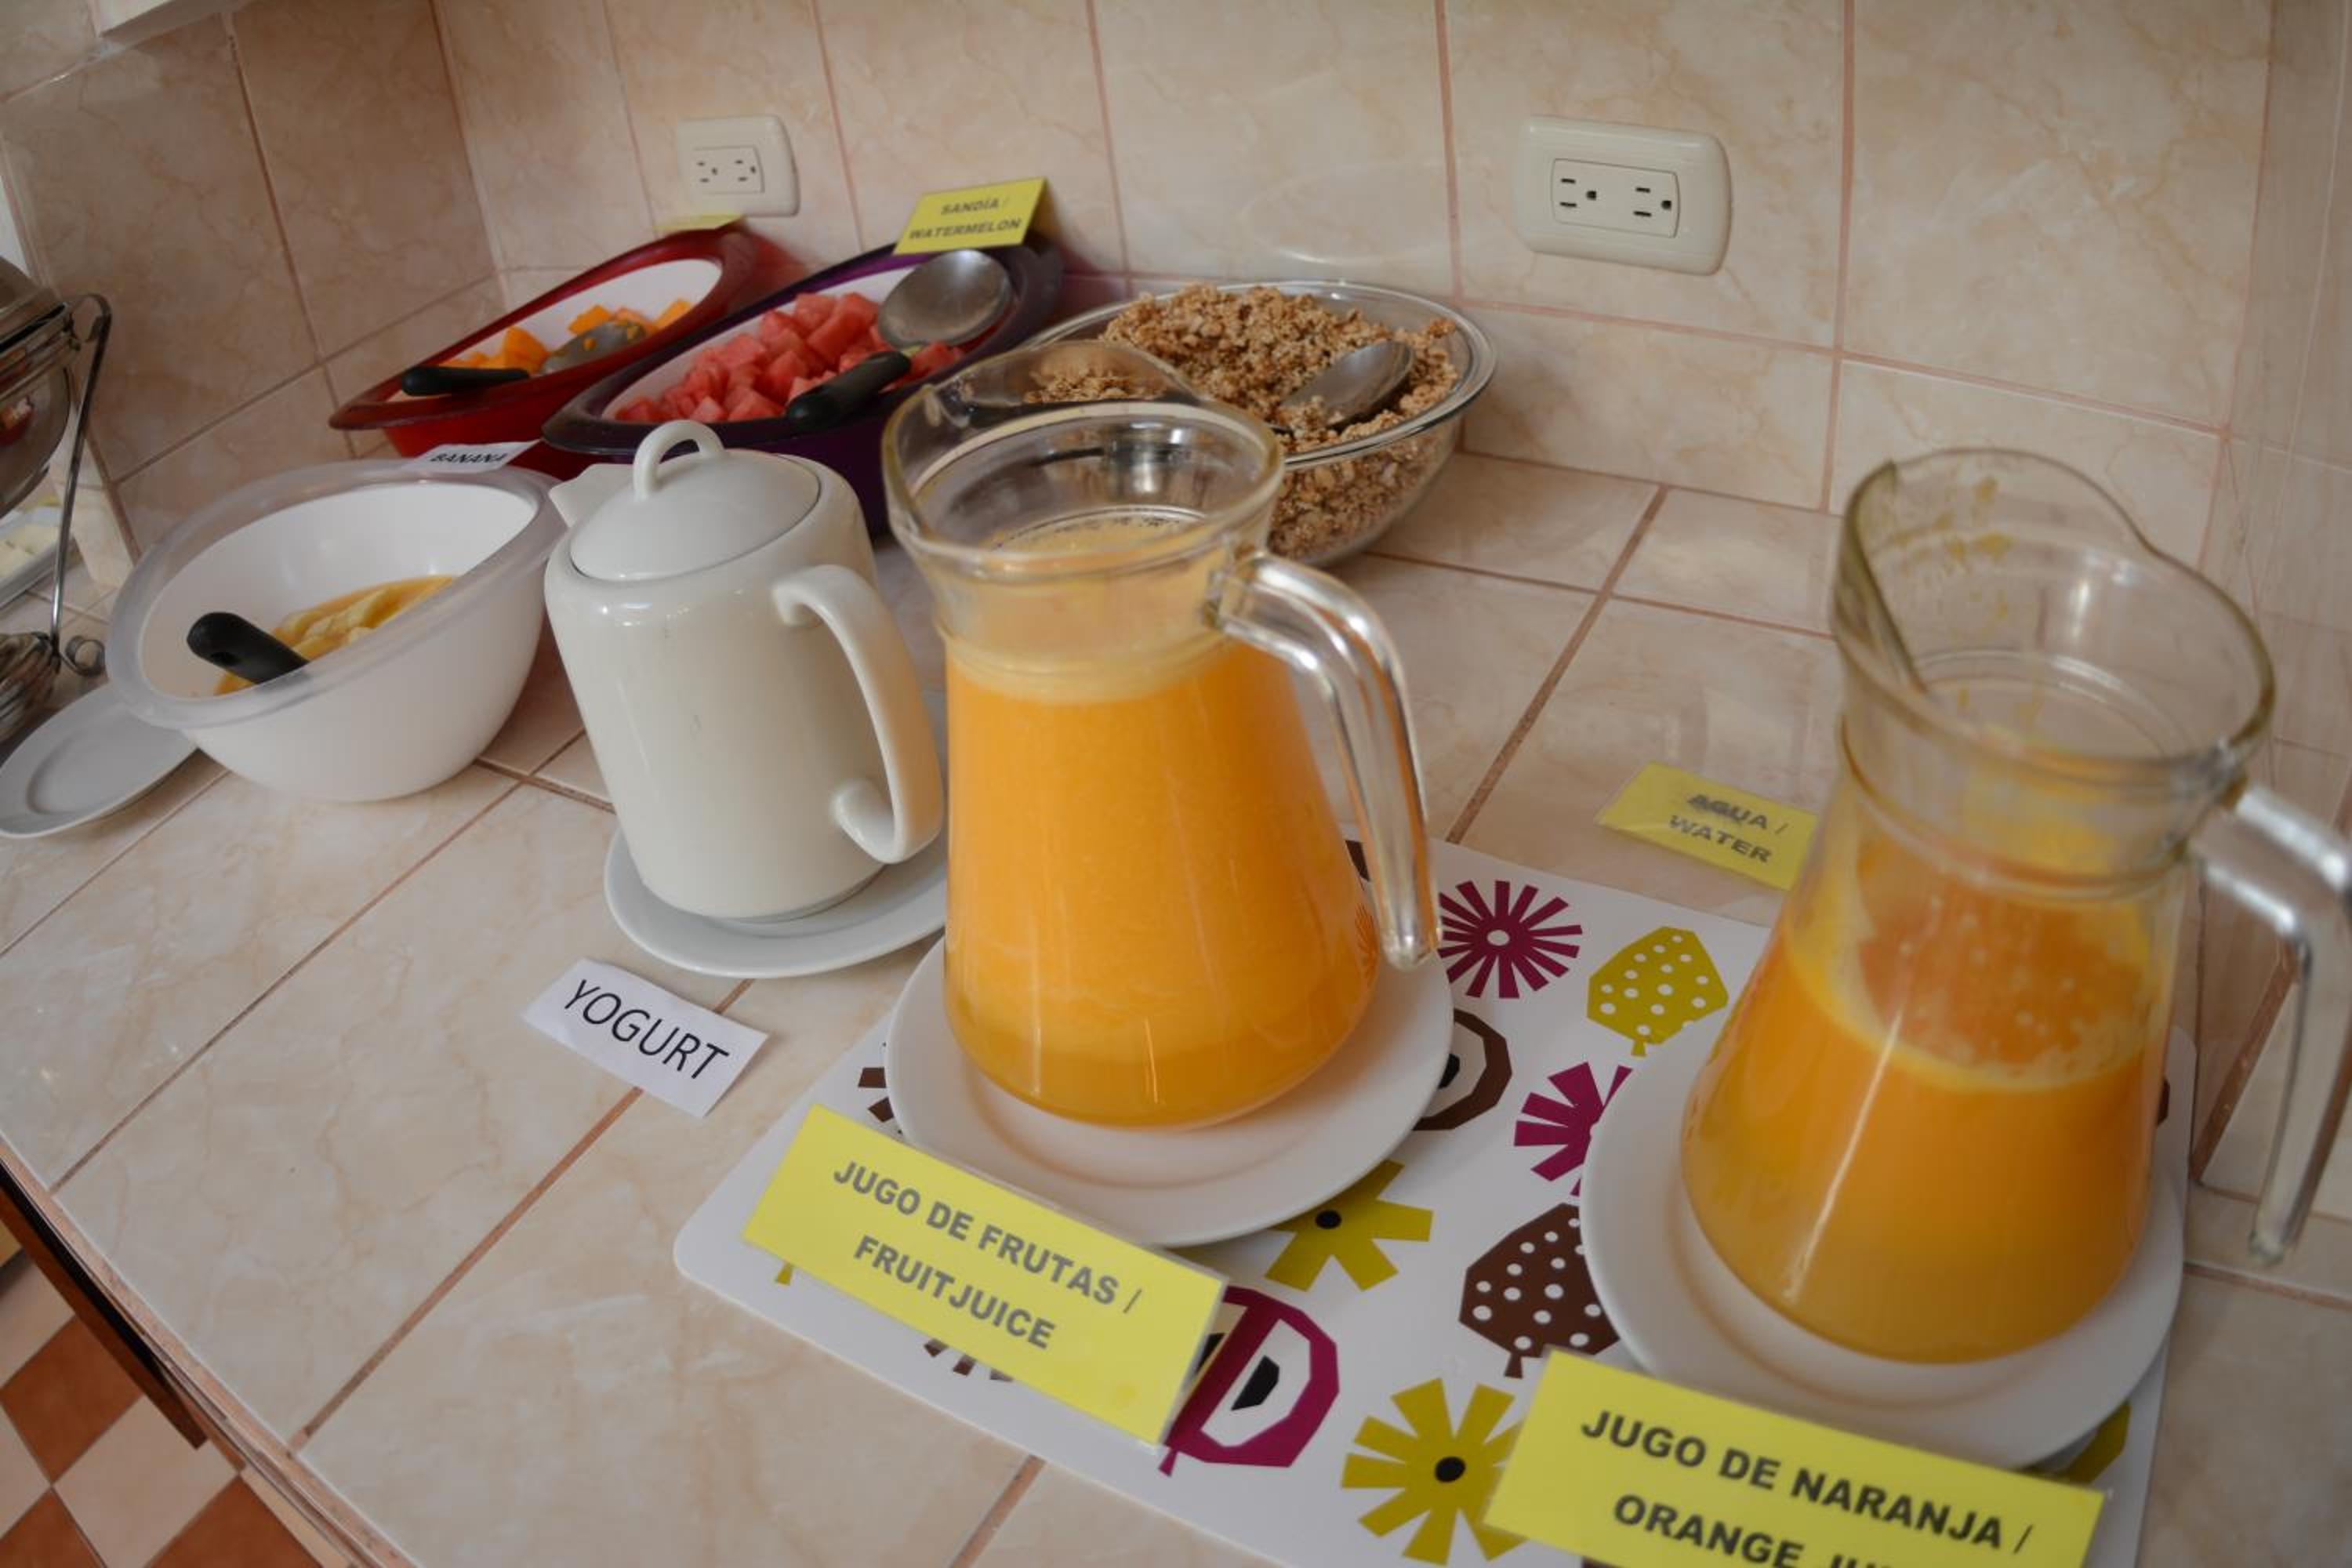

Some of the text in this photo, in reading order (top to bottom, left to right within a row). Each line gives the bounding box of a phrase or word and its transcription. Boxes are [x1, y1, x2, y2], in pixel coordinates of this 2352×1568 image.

[908, 217, 1022, 239] WATERMELON
[430, 452, 509, 463] BANANA
[1669, 815, 1773, 863] WATER
[1686, 793, 1769, 830] AGUA
[564, 979, 730, 1080] YOGURT
[833, 1160, 921, 1216] JUGO
[926, 1200, 975, 1242] DE
[978, 1224, 1120, 1305] FRUTAS
[853, 1234, 1056, 1350] FRUITJUICE
[1581, 1410, 1707, 1468] JUGO
[1718, 1447, 1782, 1491] DE
[1790, 1467, 2002, 1549] NARANJA
[1613, 1494, 1806, 1568] ORANGE
